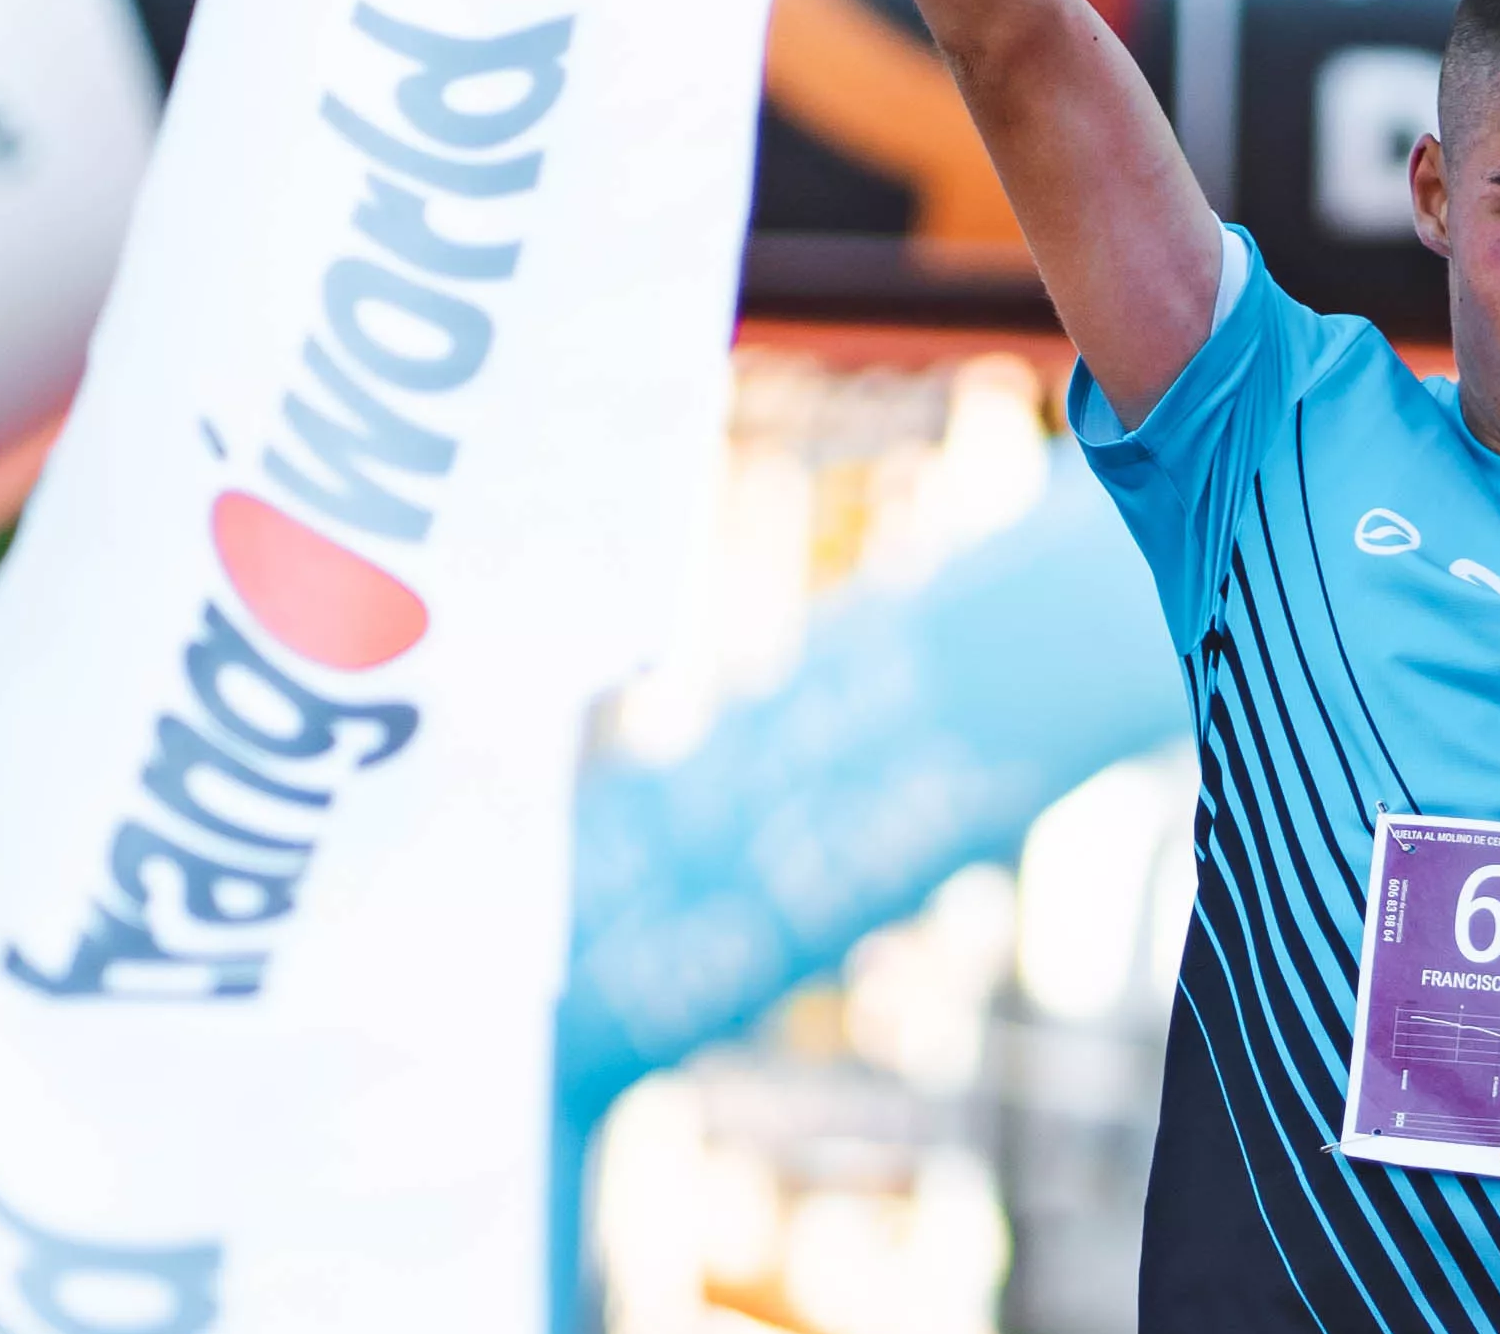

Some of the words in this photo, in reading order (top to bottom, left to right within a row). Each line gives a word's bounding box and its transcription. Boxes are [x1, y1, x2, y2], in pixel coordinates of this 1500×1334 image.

[1387, 878, 1400, 898] 606
[1386, 899, 1398, 912] 83
[1384, 914, 1396, 927] 98
[1383, 929, 1395, 942] 64
